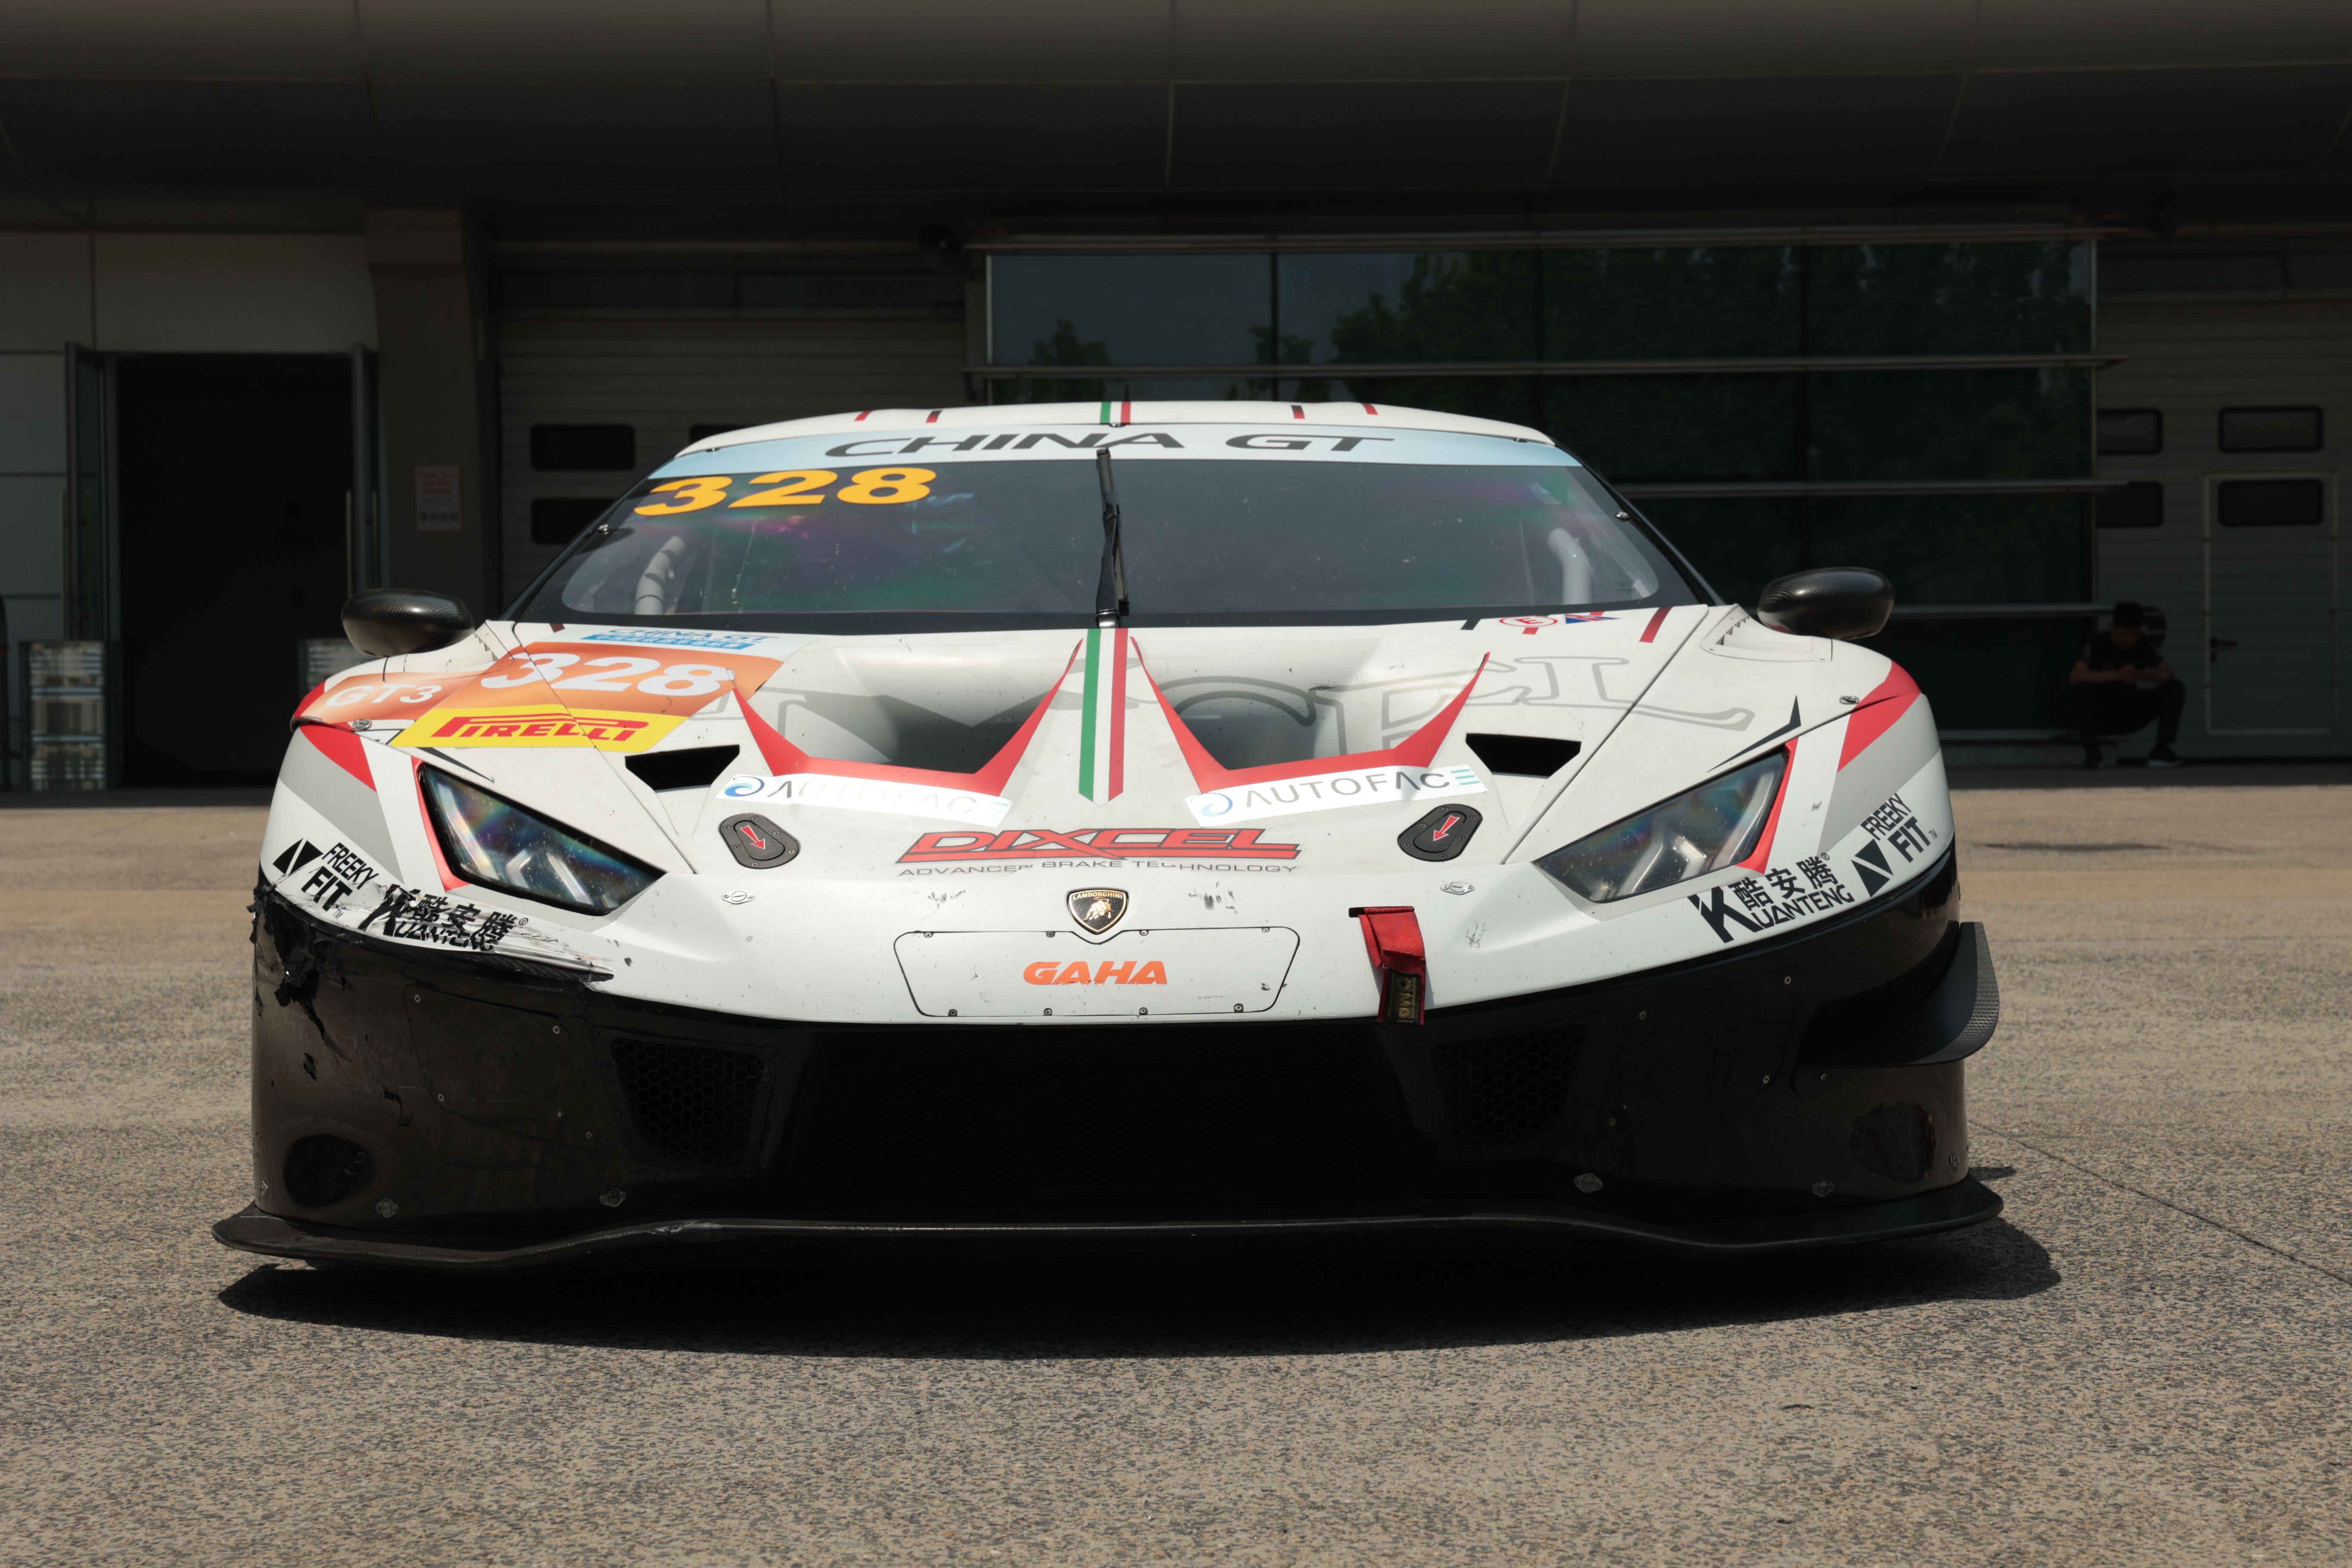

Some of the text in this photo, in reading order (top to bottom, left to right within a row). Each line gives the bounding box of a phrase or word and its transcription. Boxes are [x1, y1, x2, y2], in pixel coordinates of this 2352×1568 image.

[824, 433, 1394, 457] CHINA GT
[634, 467, 936, 515] 328
[481, 652, 735, 696] 328
[325, 684, 443, 705] GT3
[432, 713, 648, 741] PIRELLI
[1860, 793, 1912, 840] FREEKY
[895, 828, 1302, 864] DIXCEL
[1888, 816, 1931, 863] FIT
[322, 842, 379, 890] FREEKY
[301, 866, 353, 912] FIT
[1073, 891, 1122, 900] LAMBORGHINI
[1023, 961, 1168, 985] GAHA
